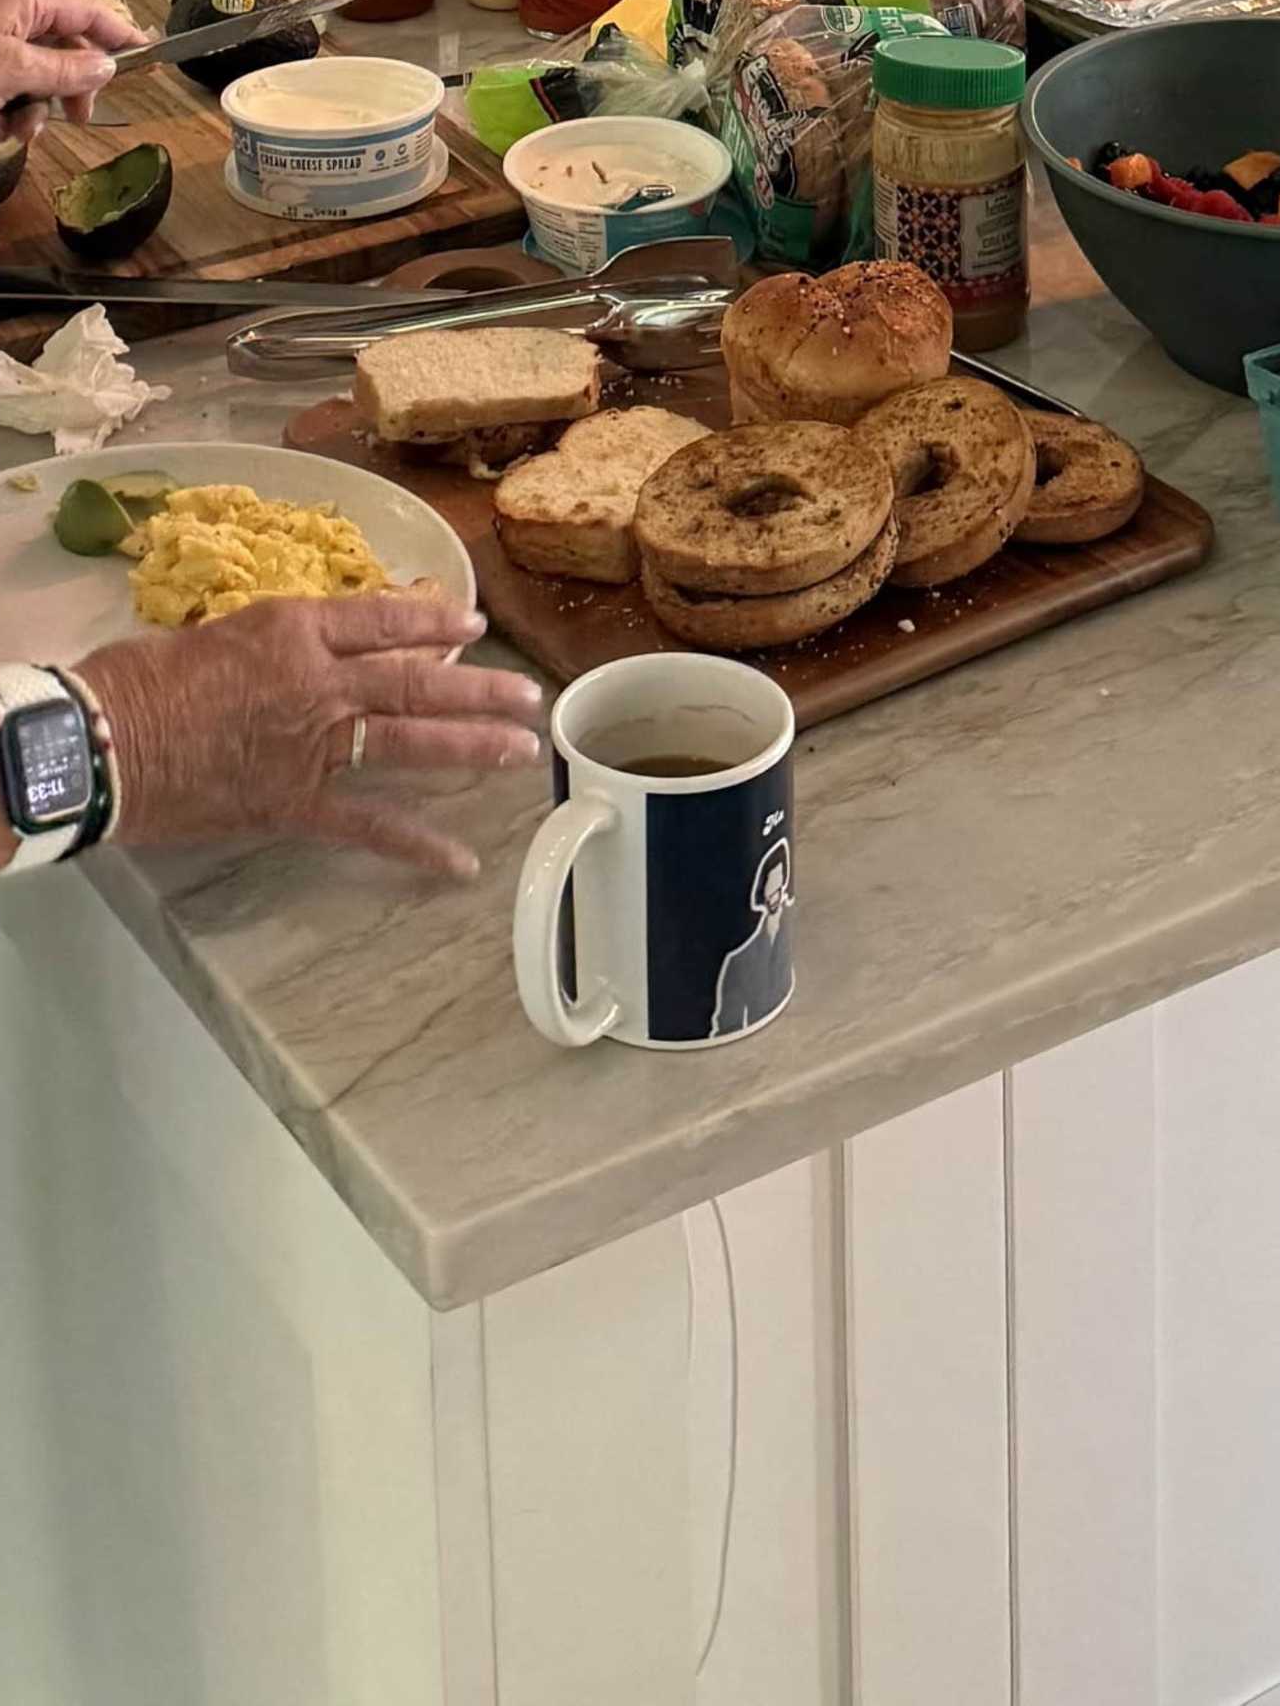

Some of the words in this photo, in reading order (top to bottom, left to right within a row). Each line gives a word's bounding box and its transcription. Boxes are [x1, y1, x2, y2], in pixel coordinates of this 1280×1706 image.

[260, 153, 287, 168] CREAM
[290, 158, 323, 172] CHEESE
[326, 156, 362, 172] SPREAD
